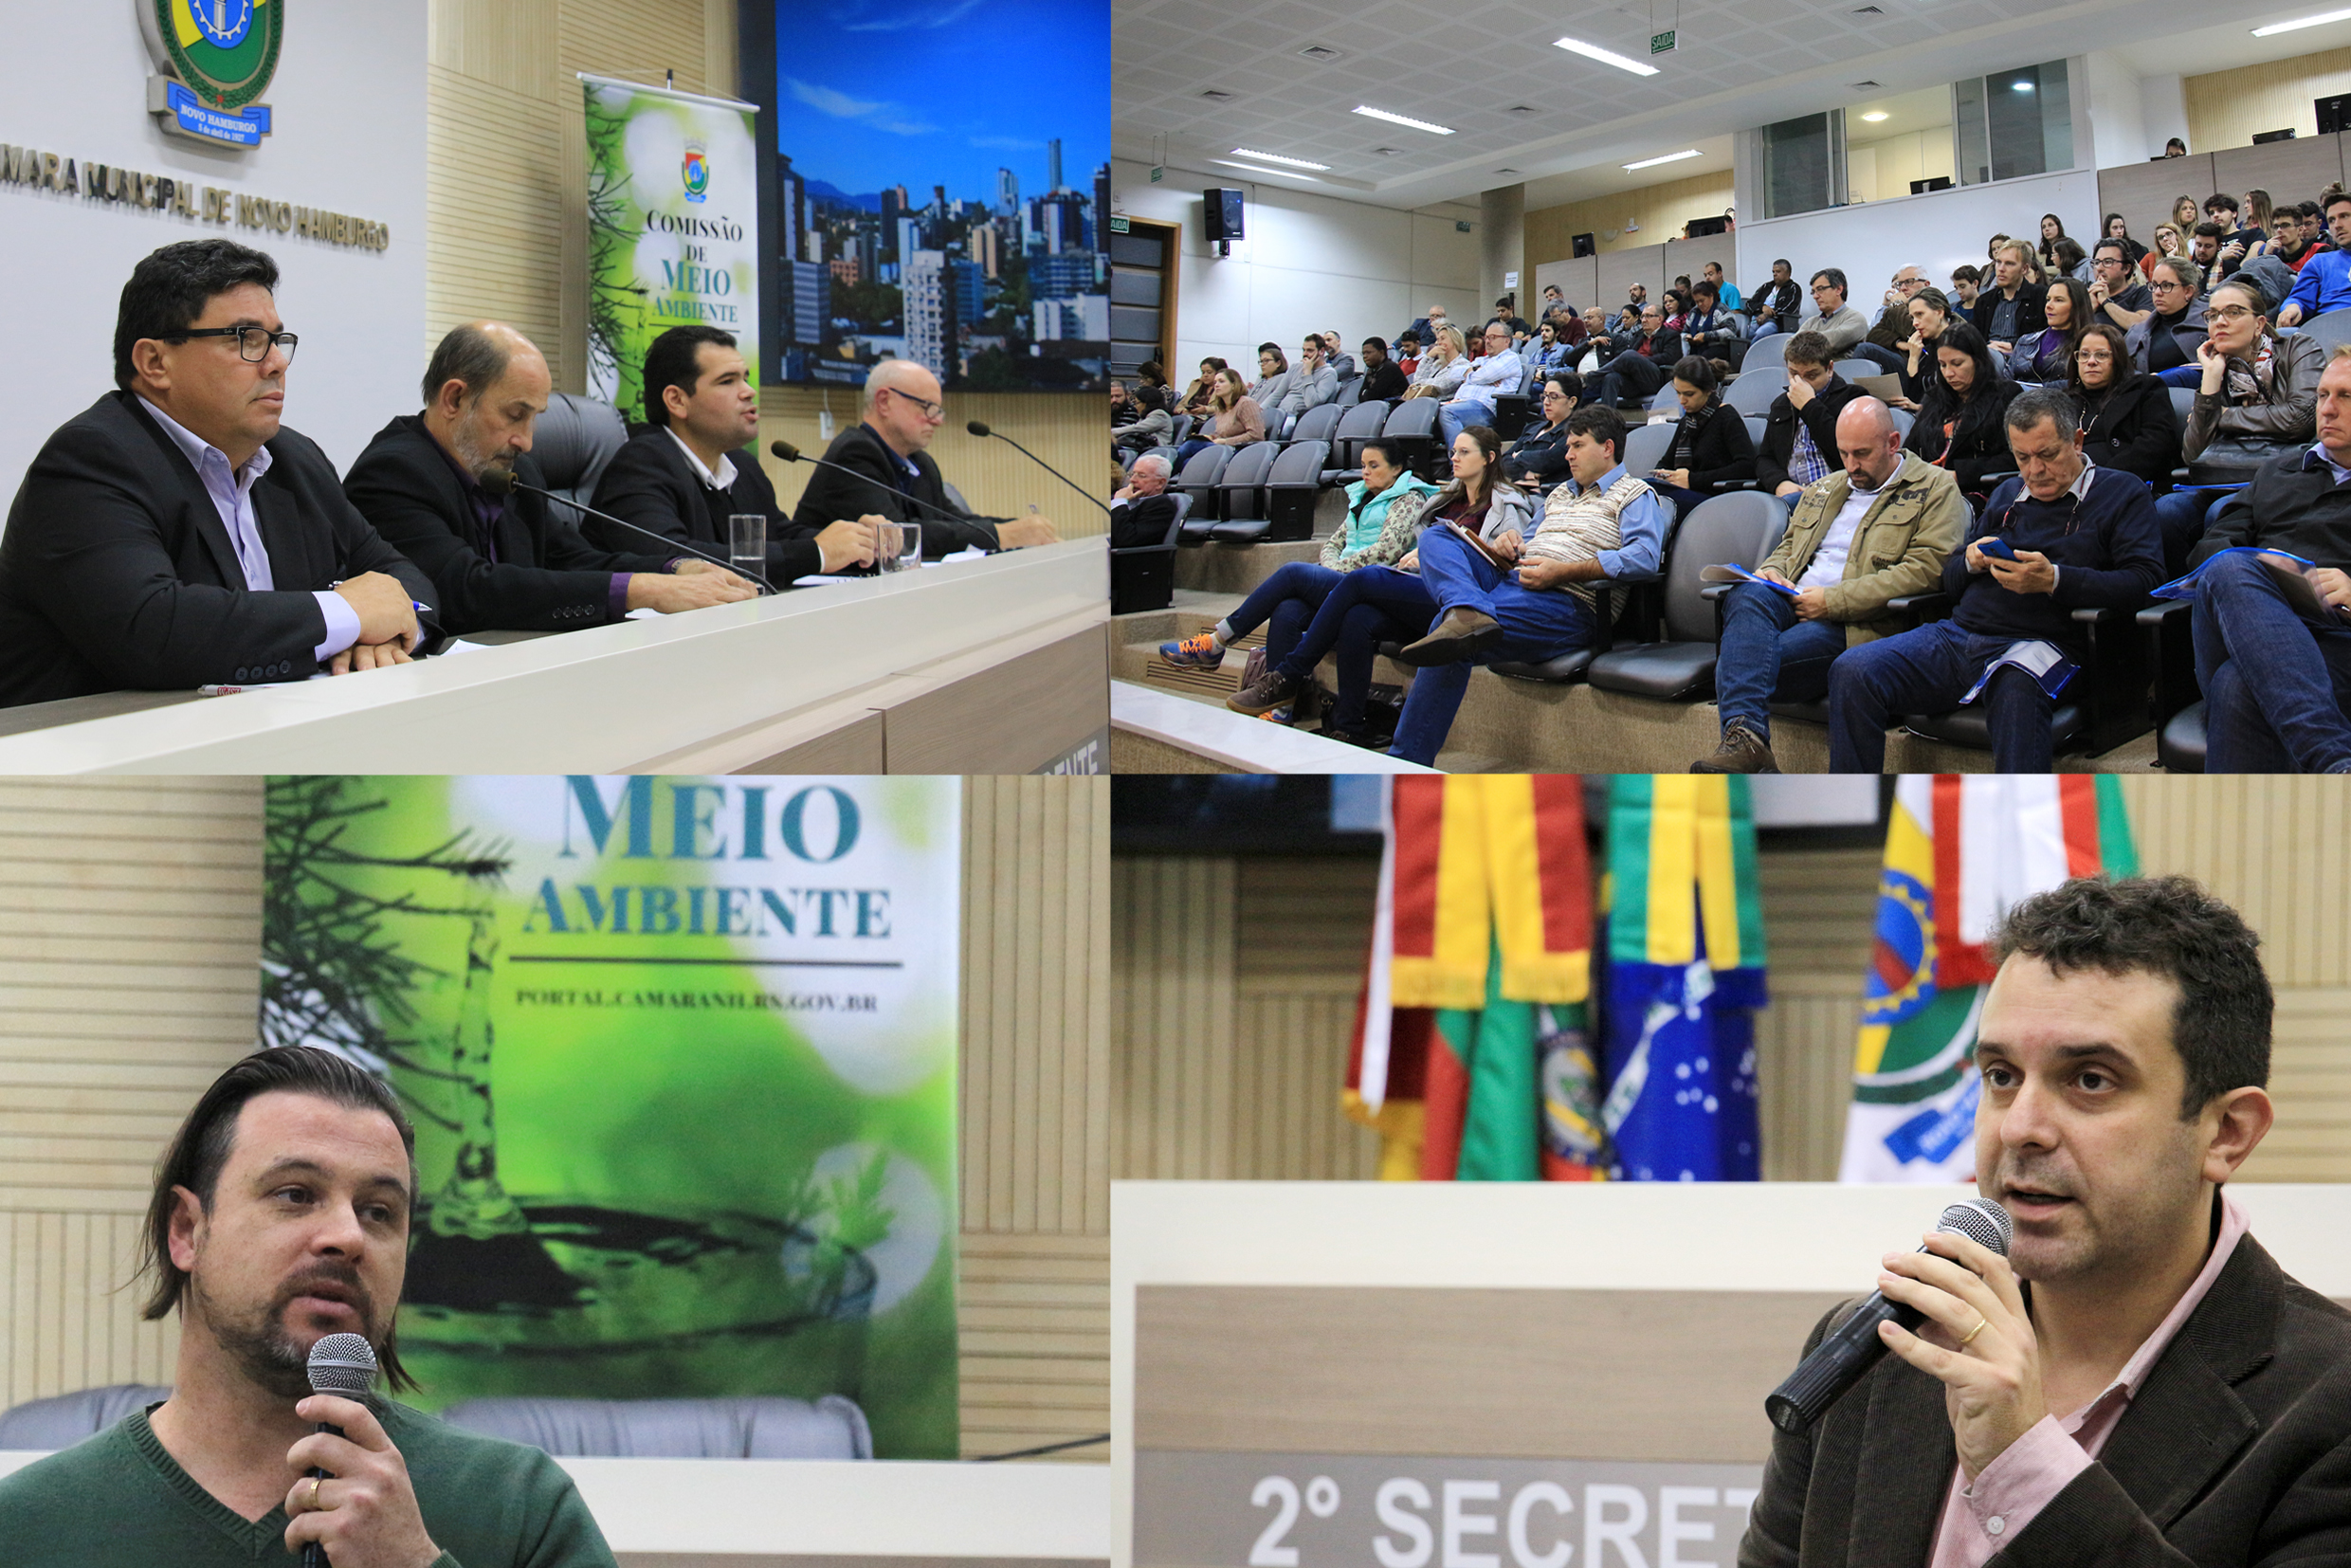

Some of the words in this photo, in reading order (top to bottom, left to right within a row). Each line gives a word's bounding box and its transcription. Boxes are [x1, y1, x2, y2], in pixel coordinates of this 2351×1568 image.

[181, 104, 206, 122] NOVO
[208, 114, 257, 134] HAMBURGO
[198, 123, 203, 132] 5
[82, 161, 200, 217] MUNICIPAL
[202, 187, 231, 224] DE
[235, 193, 292, 233] NOVO
[294, 206, 390, 251] HAMBURGO
[647, 210, 743, 242] COMISSÃO
[685, 245, 707, 263] DE
[661, 259, 731, 297] MEIO
[652, 296, 738, 323] AMBIENTE
[557, 775, 862, 864] MEIO
[522, 876, 892, 939] AMBIENTE
[1248, 1475, 1340, 1567] 2º
